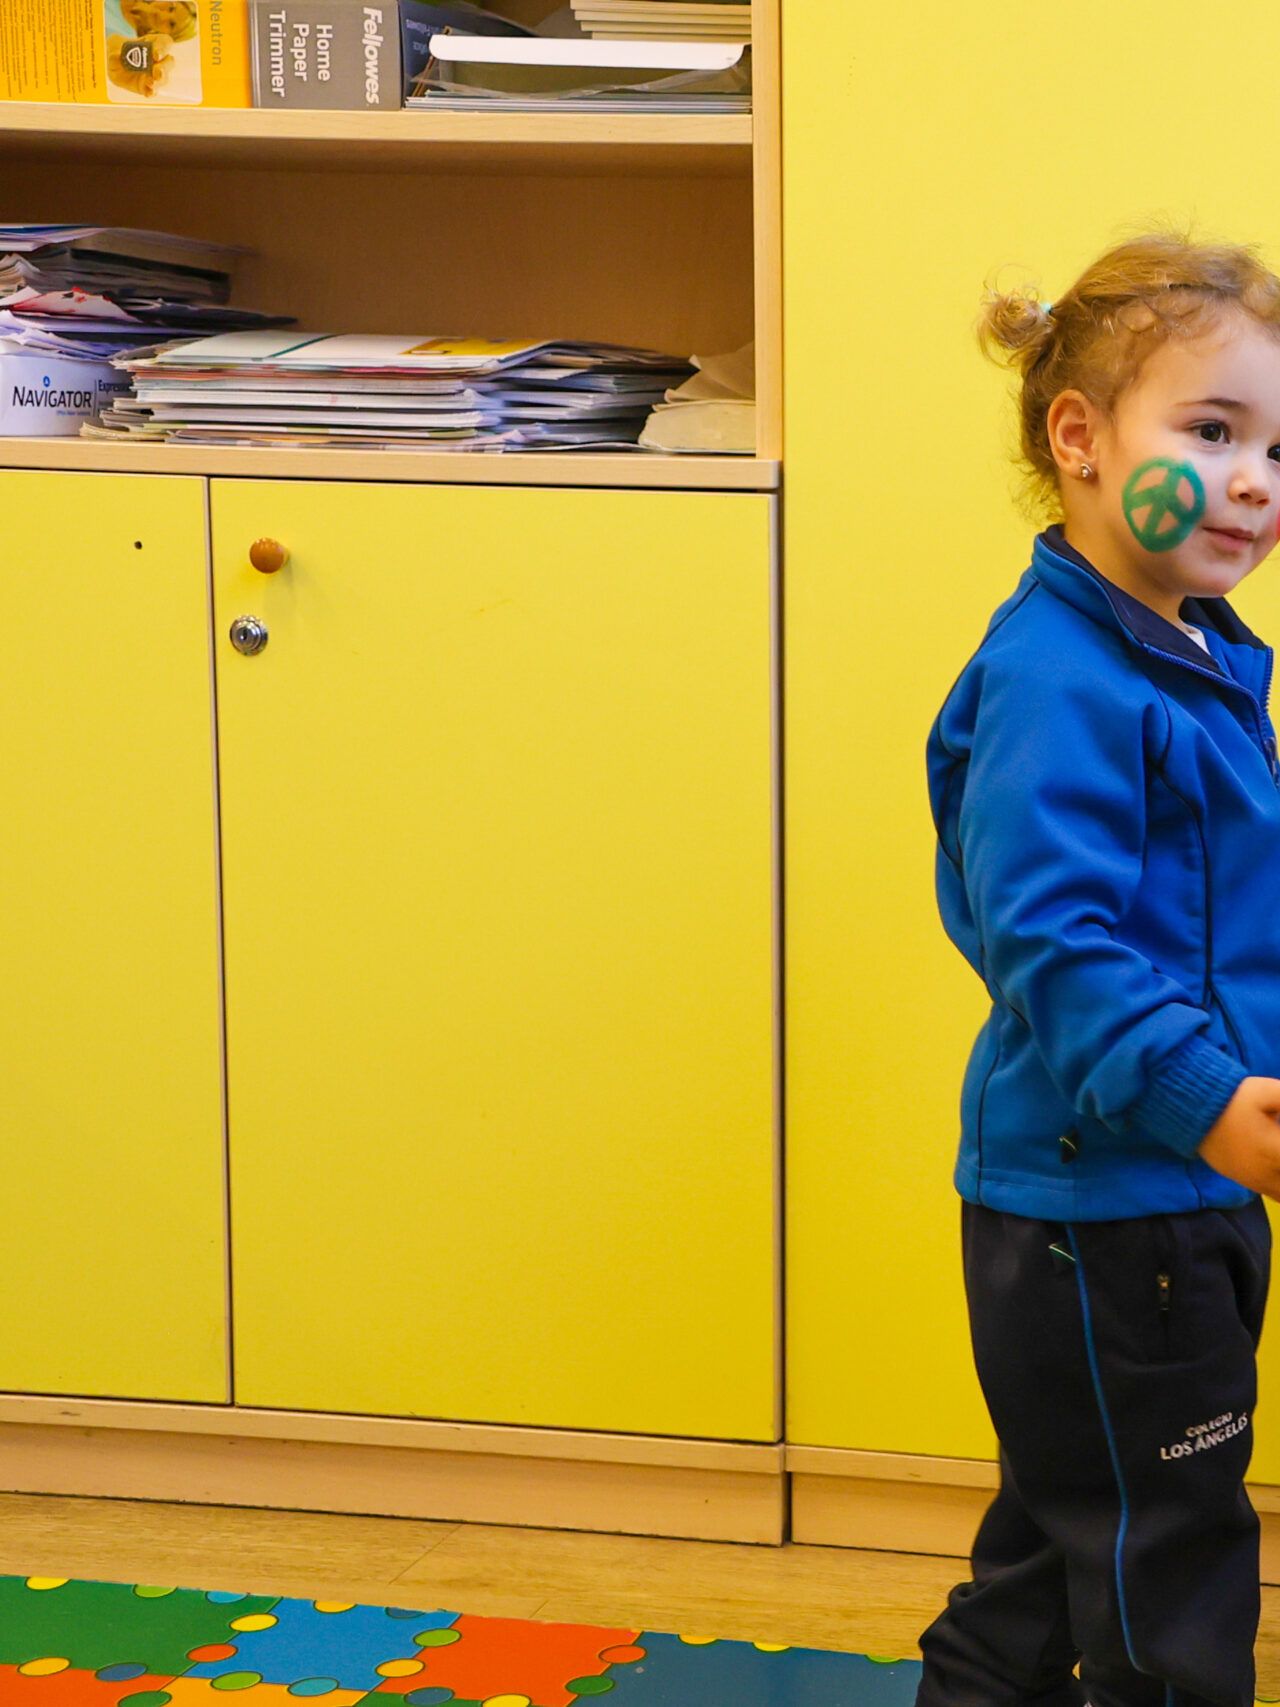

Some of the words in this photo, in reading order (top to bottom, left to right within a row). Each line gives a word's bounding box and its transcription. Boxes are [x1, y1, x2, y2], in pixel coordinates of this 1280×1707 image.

[210, 0, 223, 65] Neutron
[269, 10, 286, 98] Trimmer
[290, 23, 309, 82] Paper
[316, 24, 333, 81] Home
[362, 7, 384, 104] Fellowes
[1160, 1441, 1194, 1460] LOS
